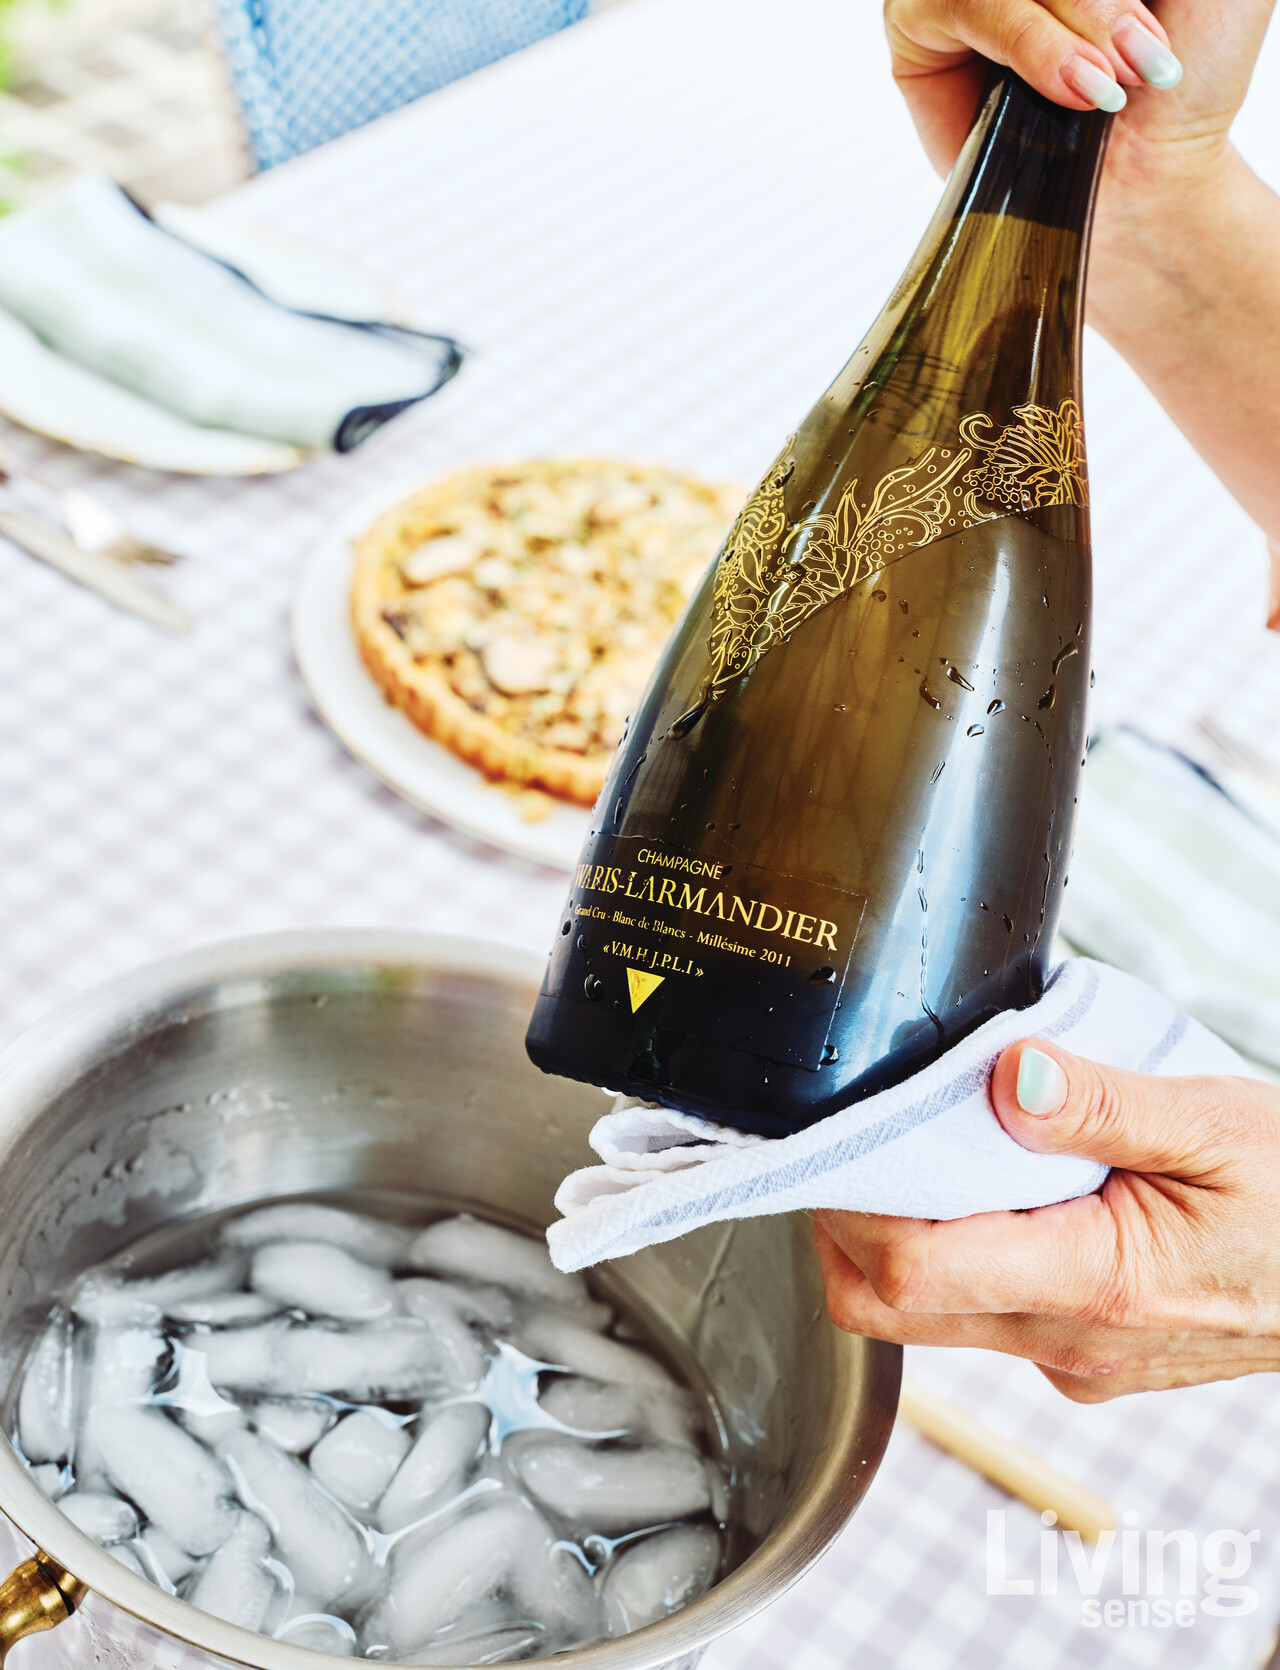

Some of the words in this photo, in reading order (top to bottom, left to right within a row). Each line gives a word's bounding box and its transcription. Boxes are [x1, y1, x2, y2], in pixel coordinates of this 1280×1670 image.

[637, 848, 724, 880] CHAMPAGNE
[574, 903, 593, 917] Grand
[592, 906, 606, 920] Cru
[612, 910, 637, 926] Blanc
[638, 916, 651, 930] de
[652, 919, 687, 939] Blancs
[696, 931, 757, 958] Millésime
[759, 948, 792, 968] 2011
